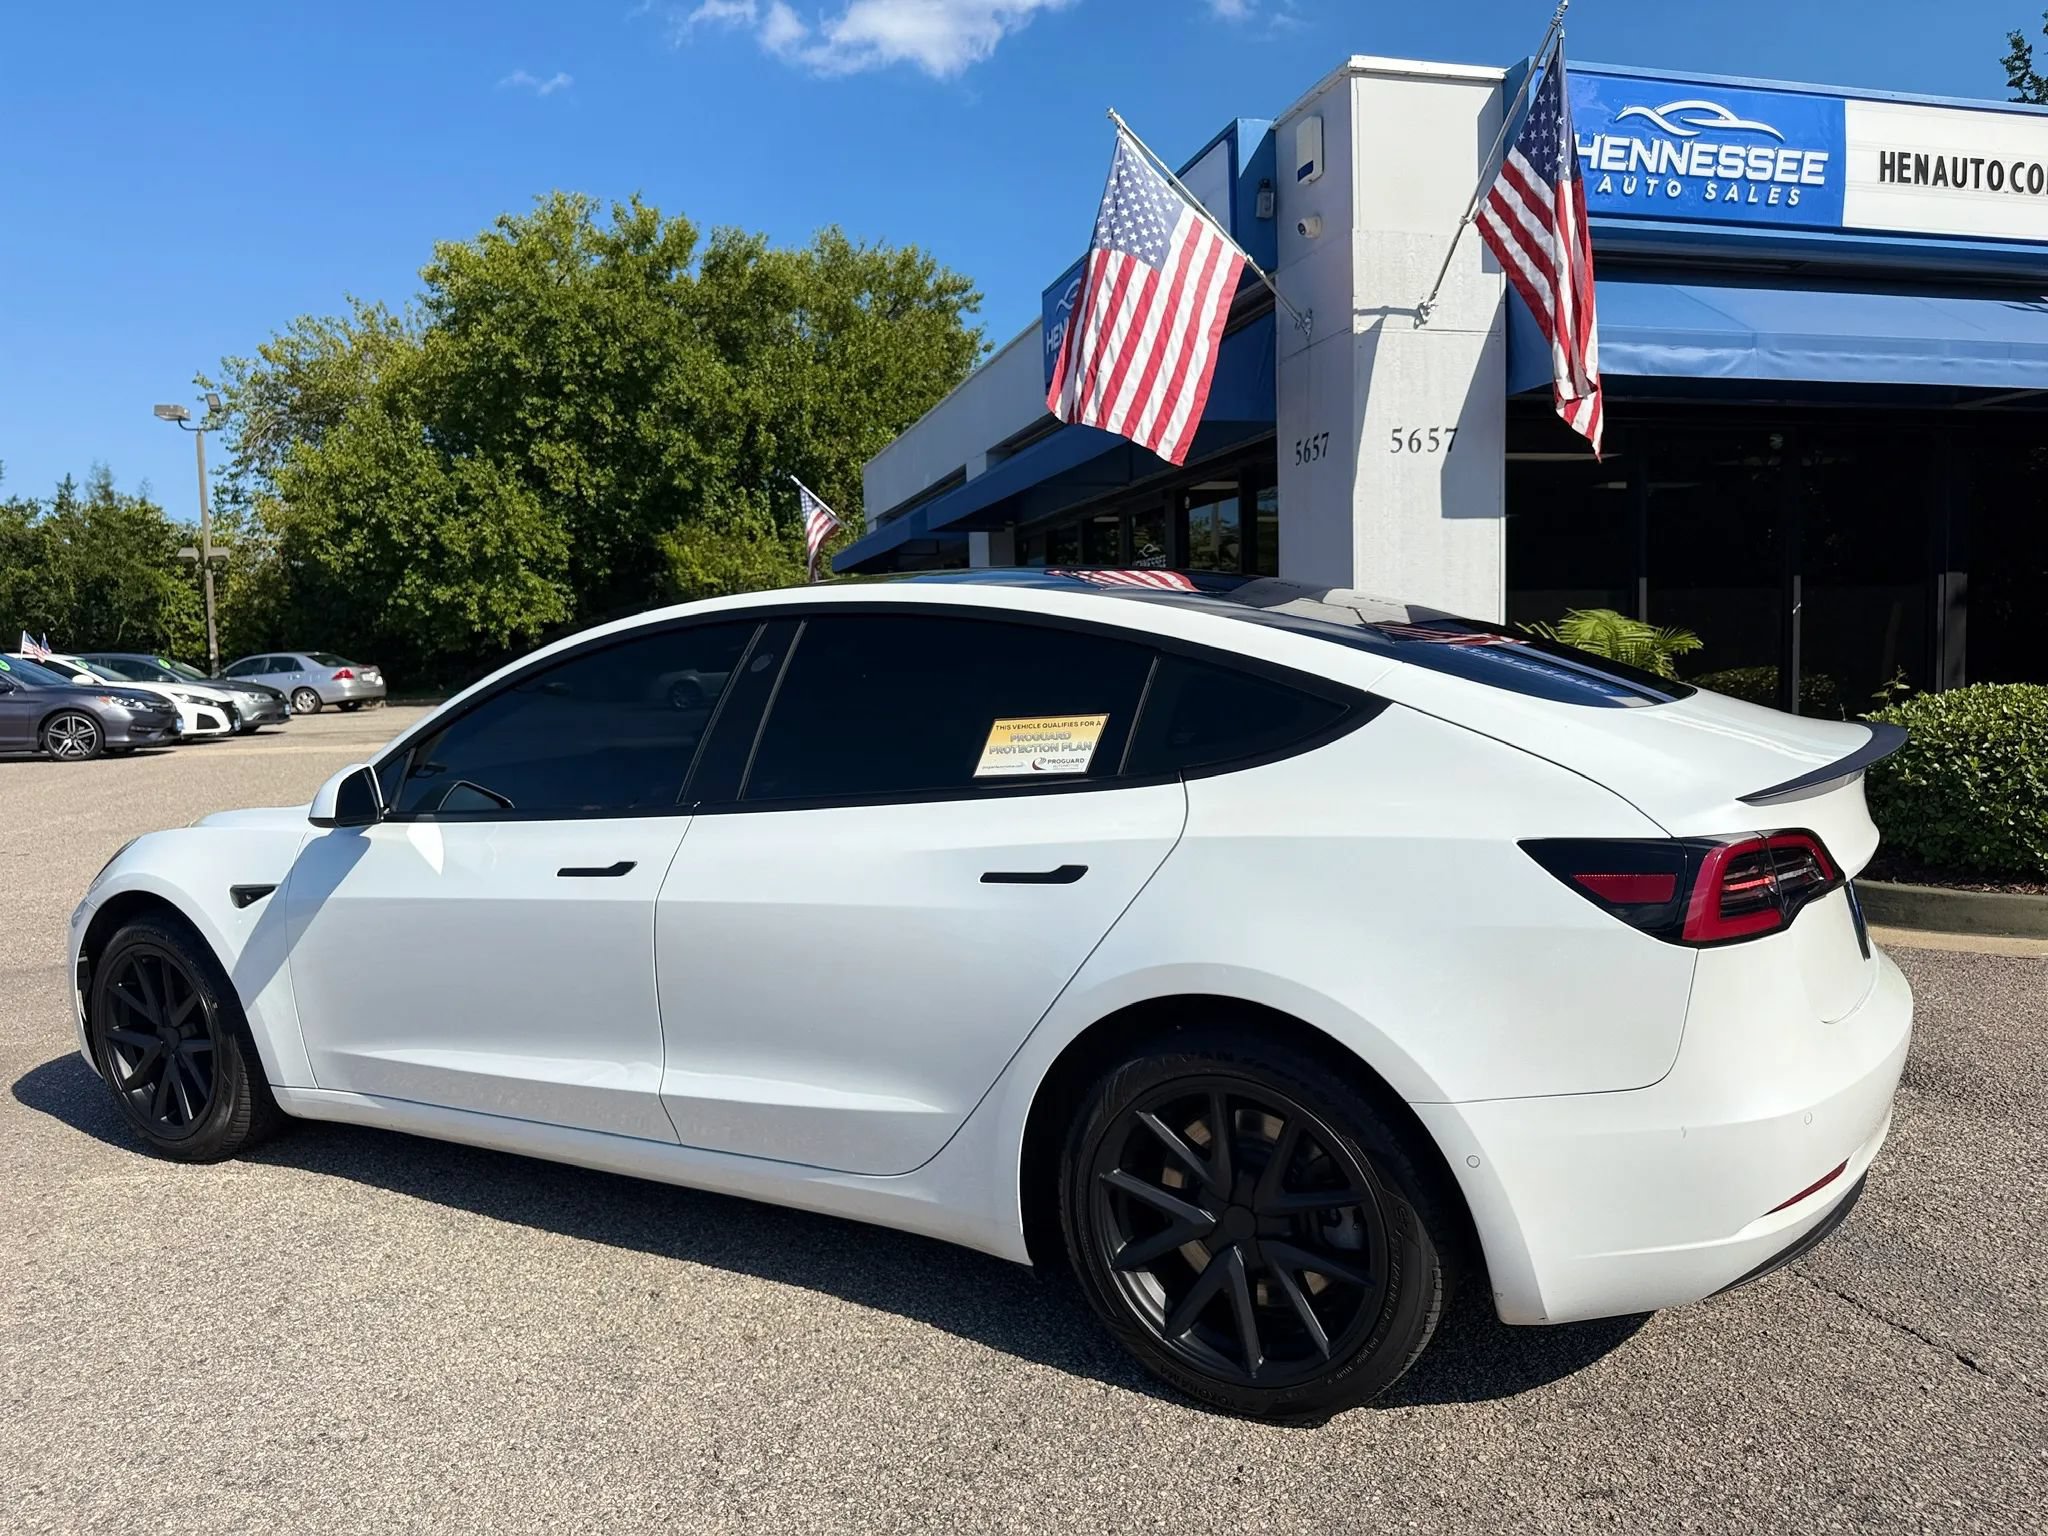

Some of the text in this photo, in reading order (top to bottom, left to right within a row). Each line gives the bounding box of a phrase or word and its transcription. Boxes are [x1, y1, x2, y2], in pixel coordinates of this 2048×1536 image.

[1574, 133, 1829, 185] HENNESSEE
[1879, 150, 2048, 196] HENAUTO.CO
[1597, 174, 1801, 206] AUTO SALES
[1295, 432, 1330, 466] 5657
[1390, 427, 1458, 453] 5657
[1010, 731, 1072, 743] PROGUARD
[1042, 721, 1079, 729] QUALIFIES
[989, 741, 1093, 755] PROTECTION PLAN
